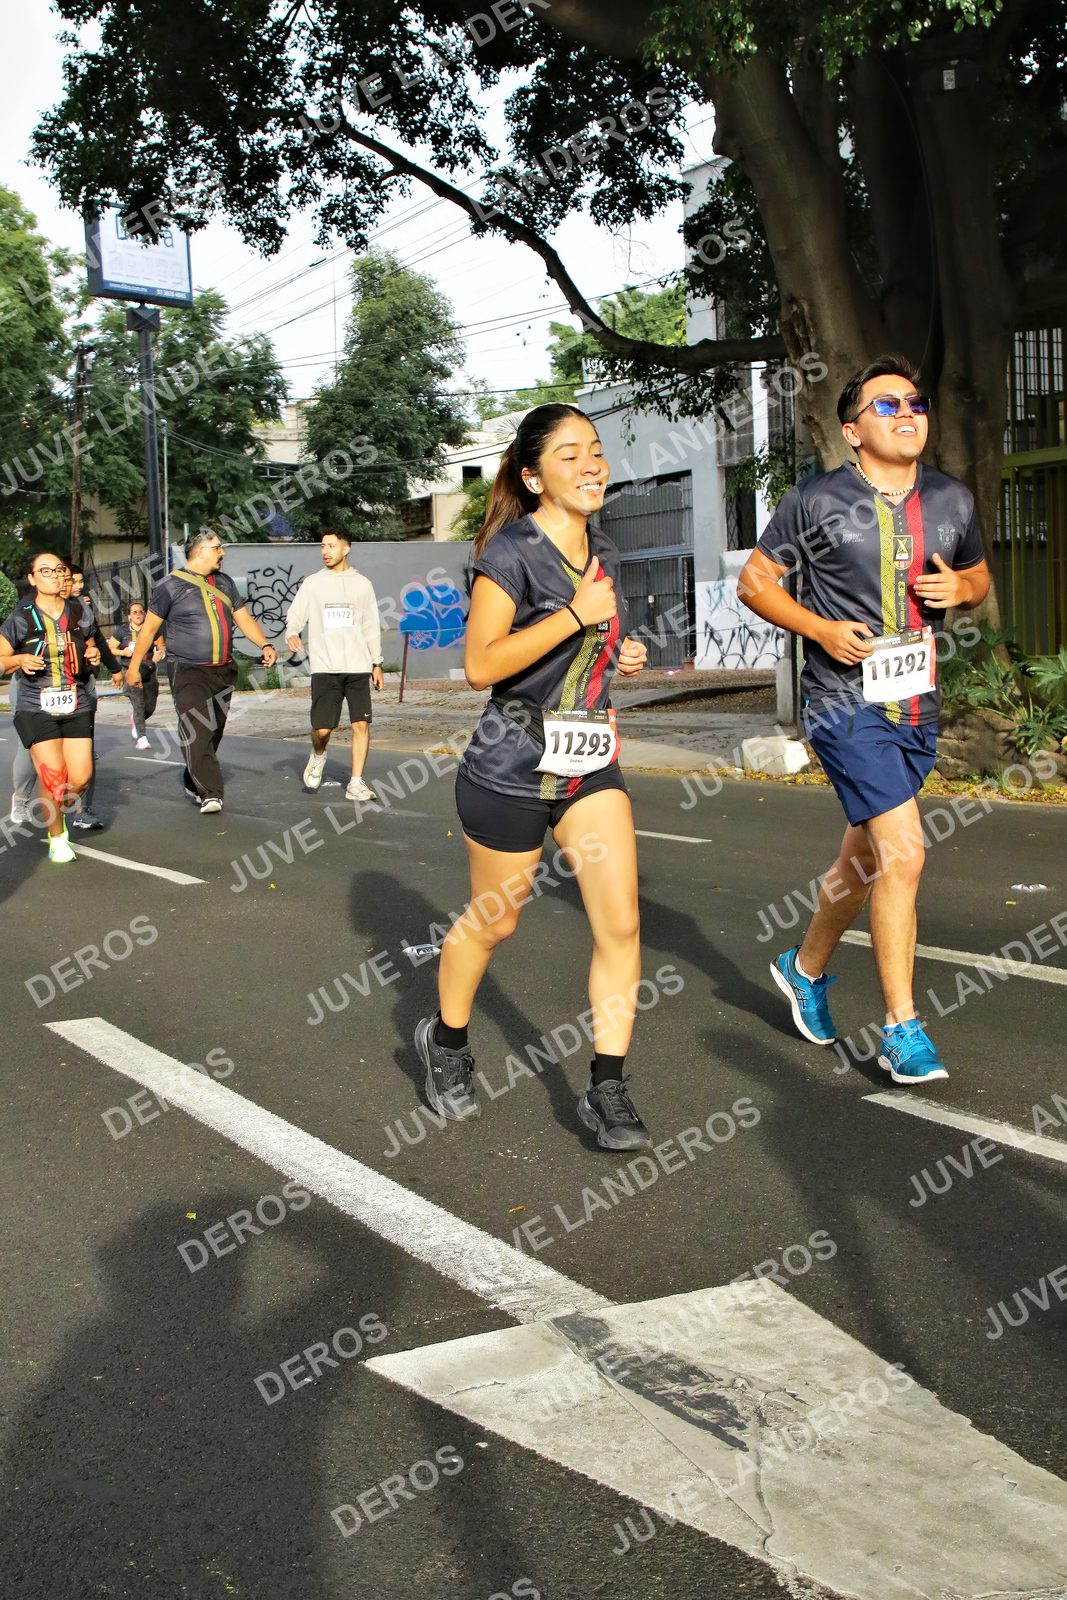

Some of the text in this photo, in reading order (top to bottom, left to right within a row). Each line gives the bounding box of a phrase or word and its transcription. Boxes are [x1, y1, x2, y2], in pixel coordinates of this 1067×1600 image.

[248, 565, 293, 582] TOY
[326, 610, 351, 619] 11972
[867, 650, 926, 680] 11292
[550, 730, 611, 756] 11293
